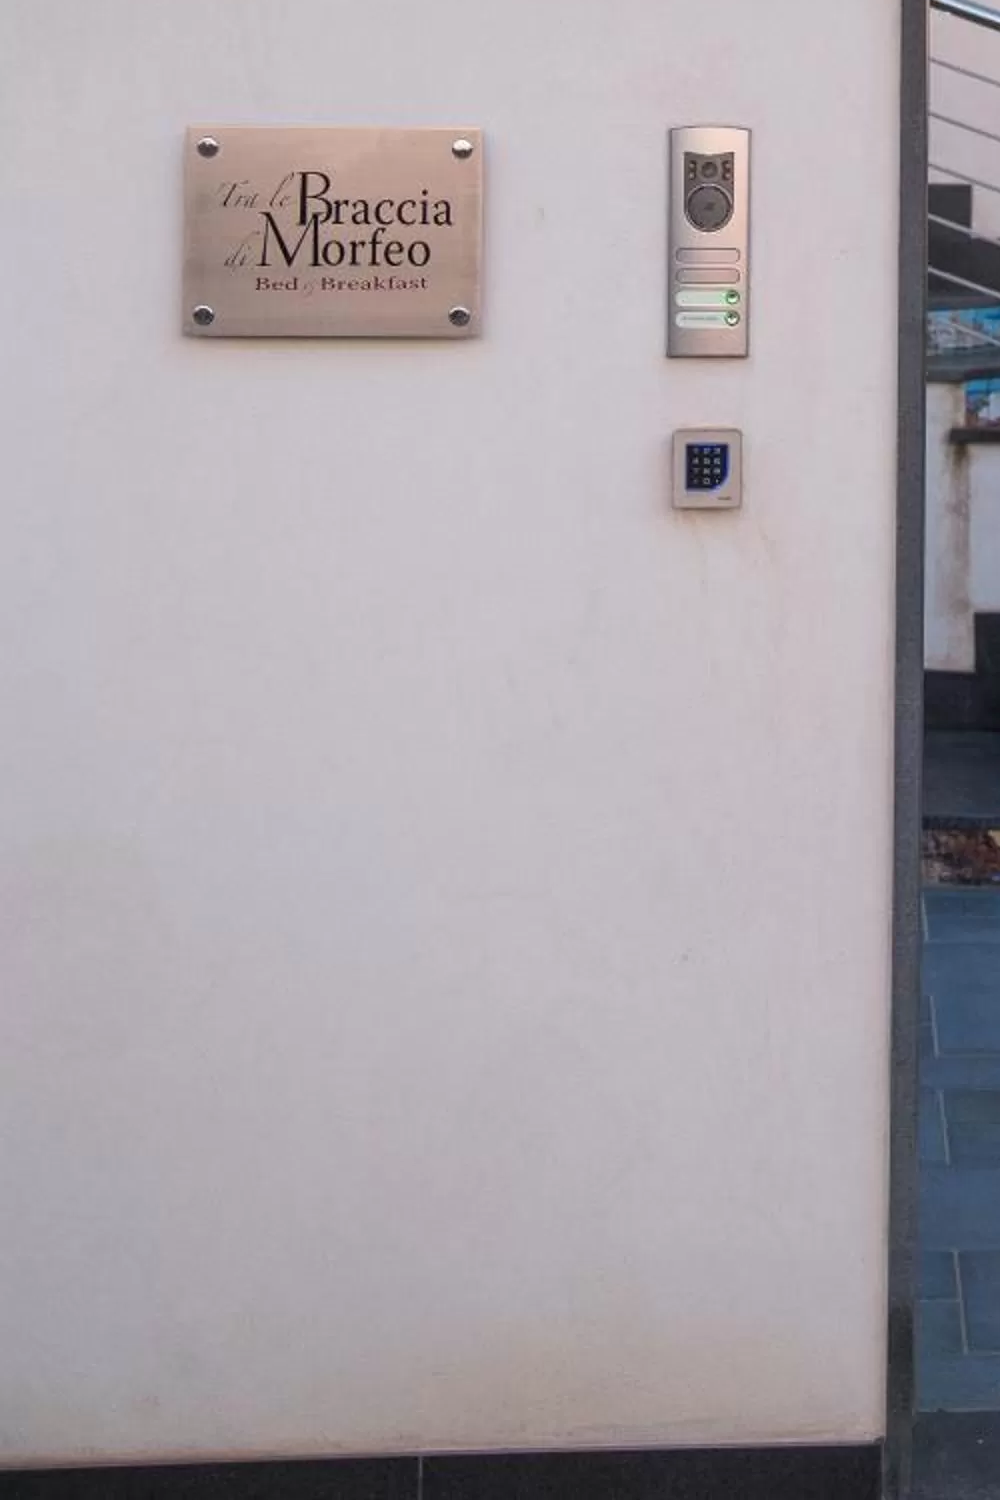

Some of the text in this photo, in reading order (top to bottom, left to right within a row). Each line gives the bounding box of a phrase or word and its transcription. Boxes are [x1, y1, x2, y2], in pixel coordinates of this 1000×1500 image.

[297, 171, 455, 226] Braccia
[256, 211, 431, 268] Morfeo
[255, 277, 299, 291] Bed
[321, 276, 429, 291] Breakfast
